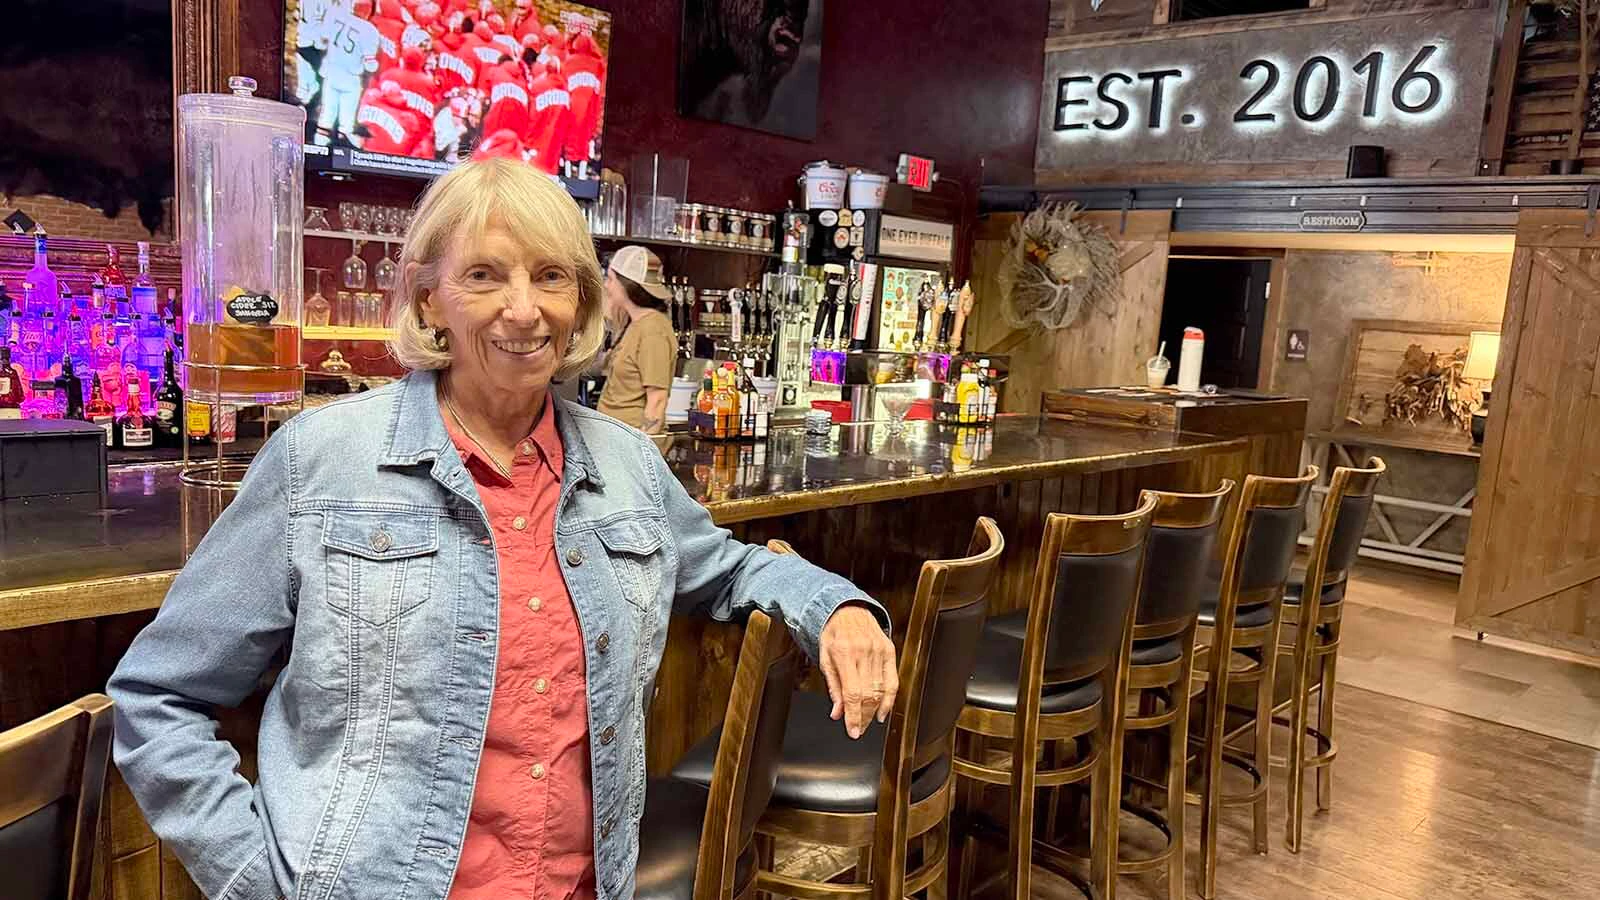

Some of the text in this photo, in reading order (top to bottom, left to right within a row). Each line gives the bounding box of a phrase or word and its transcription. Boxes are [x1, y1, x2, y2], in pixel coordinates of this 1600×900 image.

[334, 19, 360, 54] 75
[1054, 45, 1442, 131] EST. 2016
[1303, 216, 1360, 226] RESTROOM
[881, 227, 897, 242] ONE
